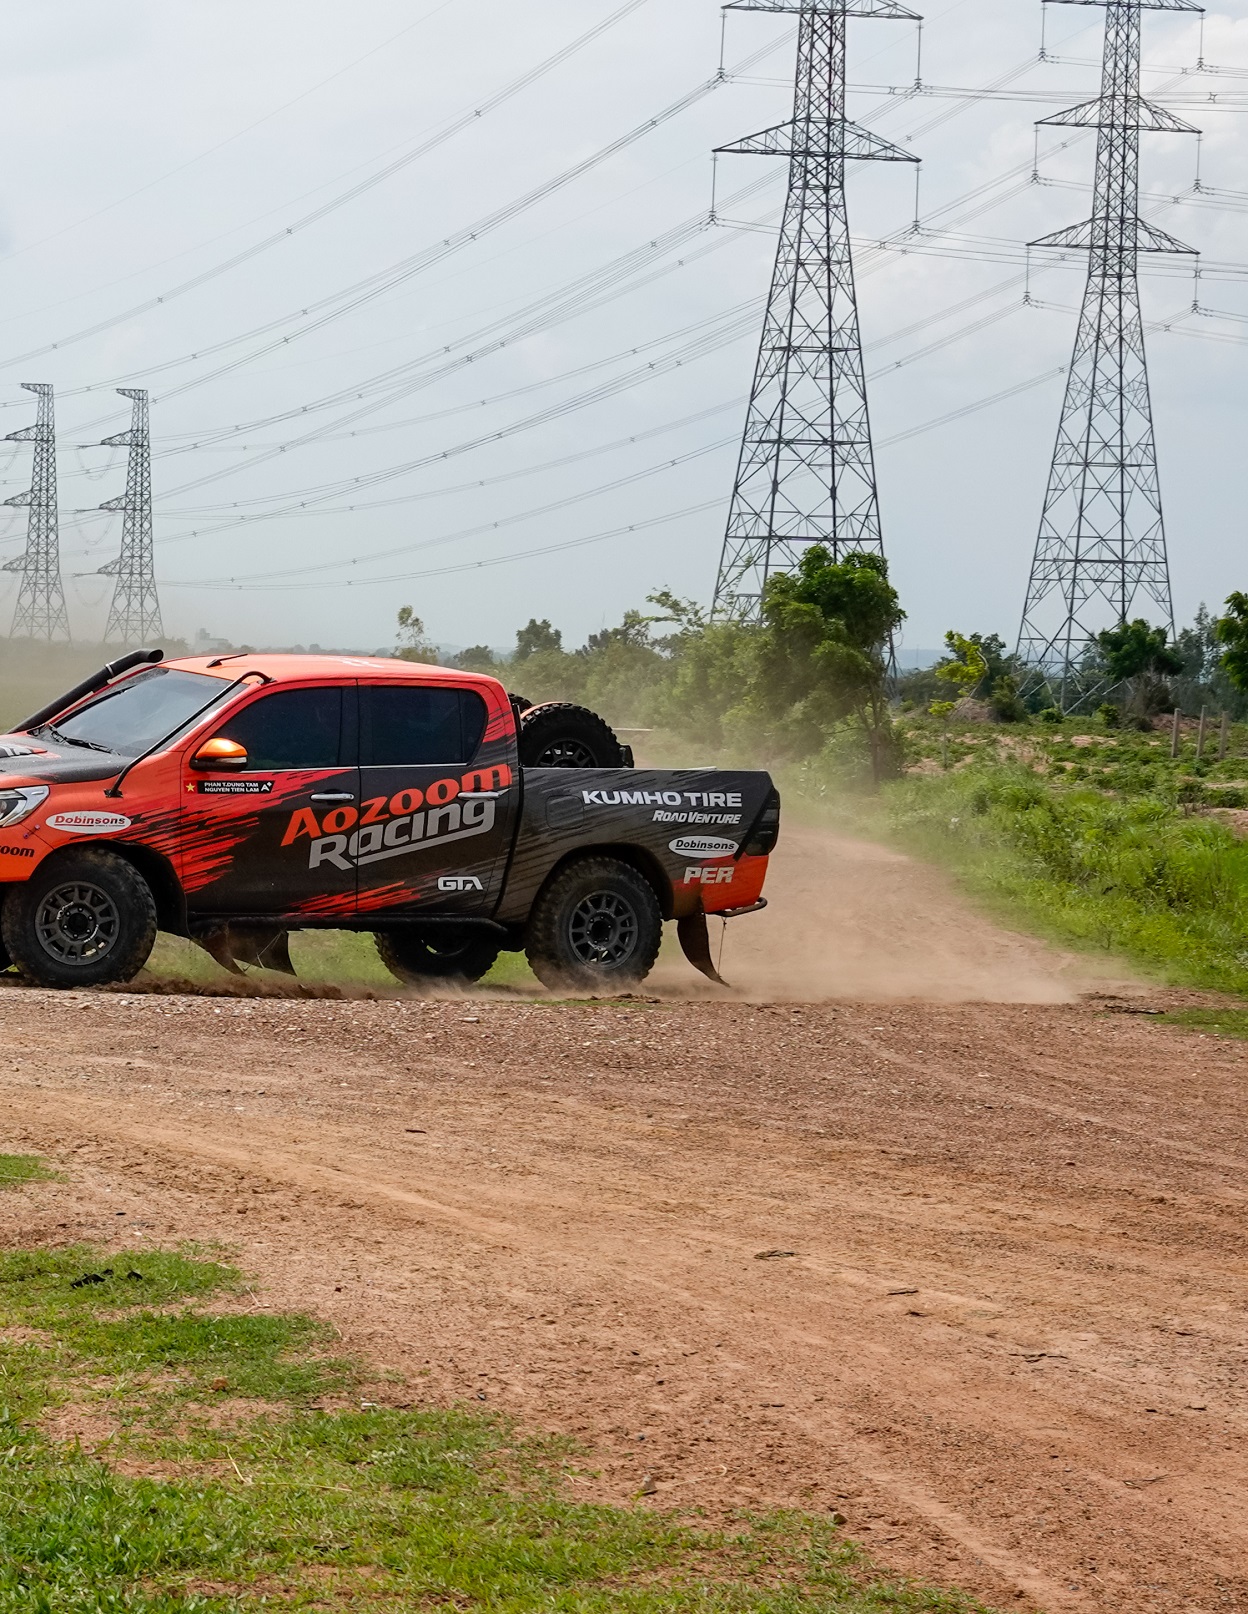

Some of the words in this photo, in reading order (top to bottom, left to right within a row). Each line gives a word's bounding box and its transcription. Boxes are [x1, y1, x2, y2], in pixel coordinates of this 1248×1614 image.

[281, 764, 512, 847] Aozoom
[582, 790, 682, 806] KUMHO
[683, 792, 742, 807] TIRE
[54, 815, 126, 826] Dobinsons
[308, 800, 496, 871] Racing
[675, 839, 735, 850] Dobinsons
[437, 876, 484, 891] GTA
[683, 866, 735, 884] PER
